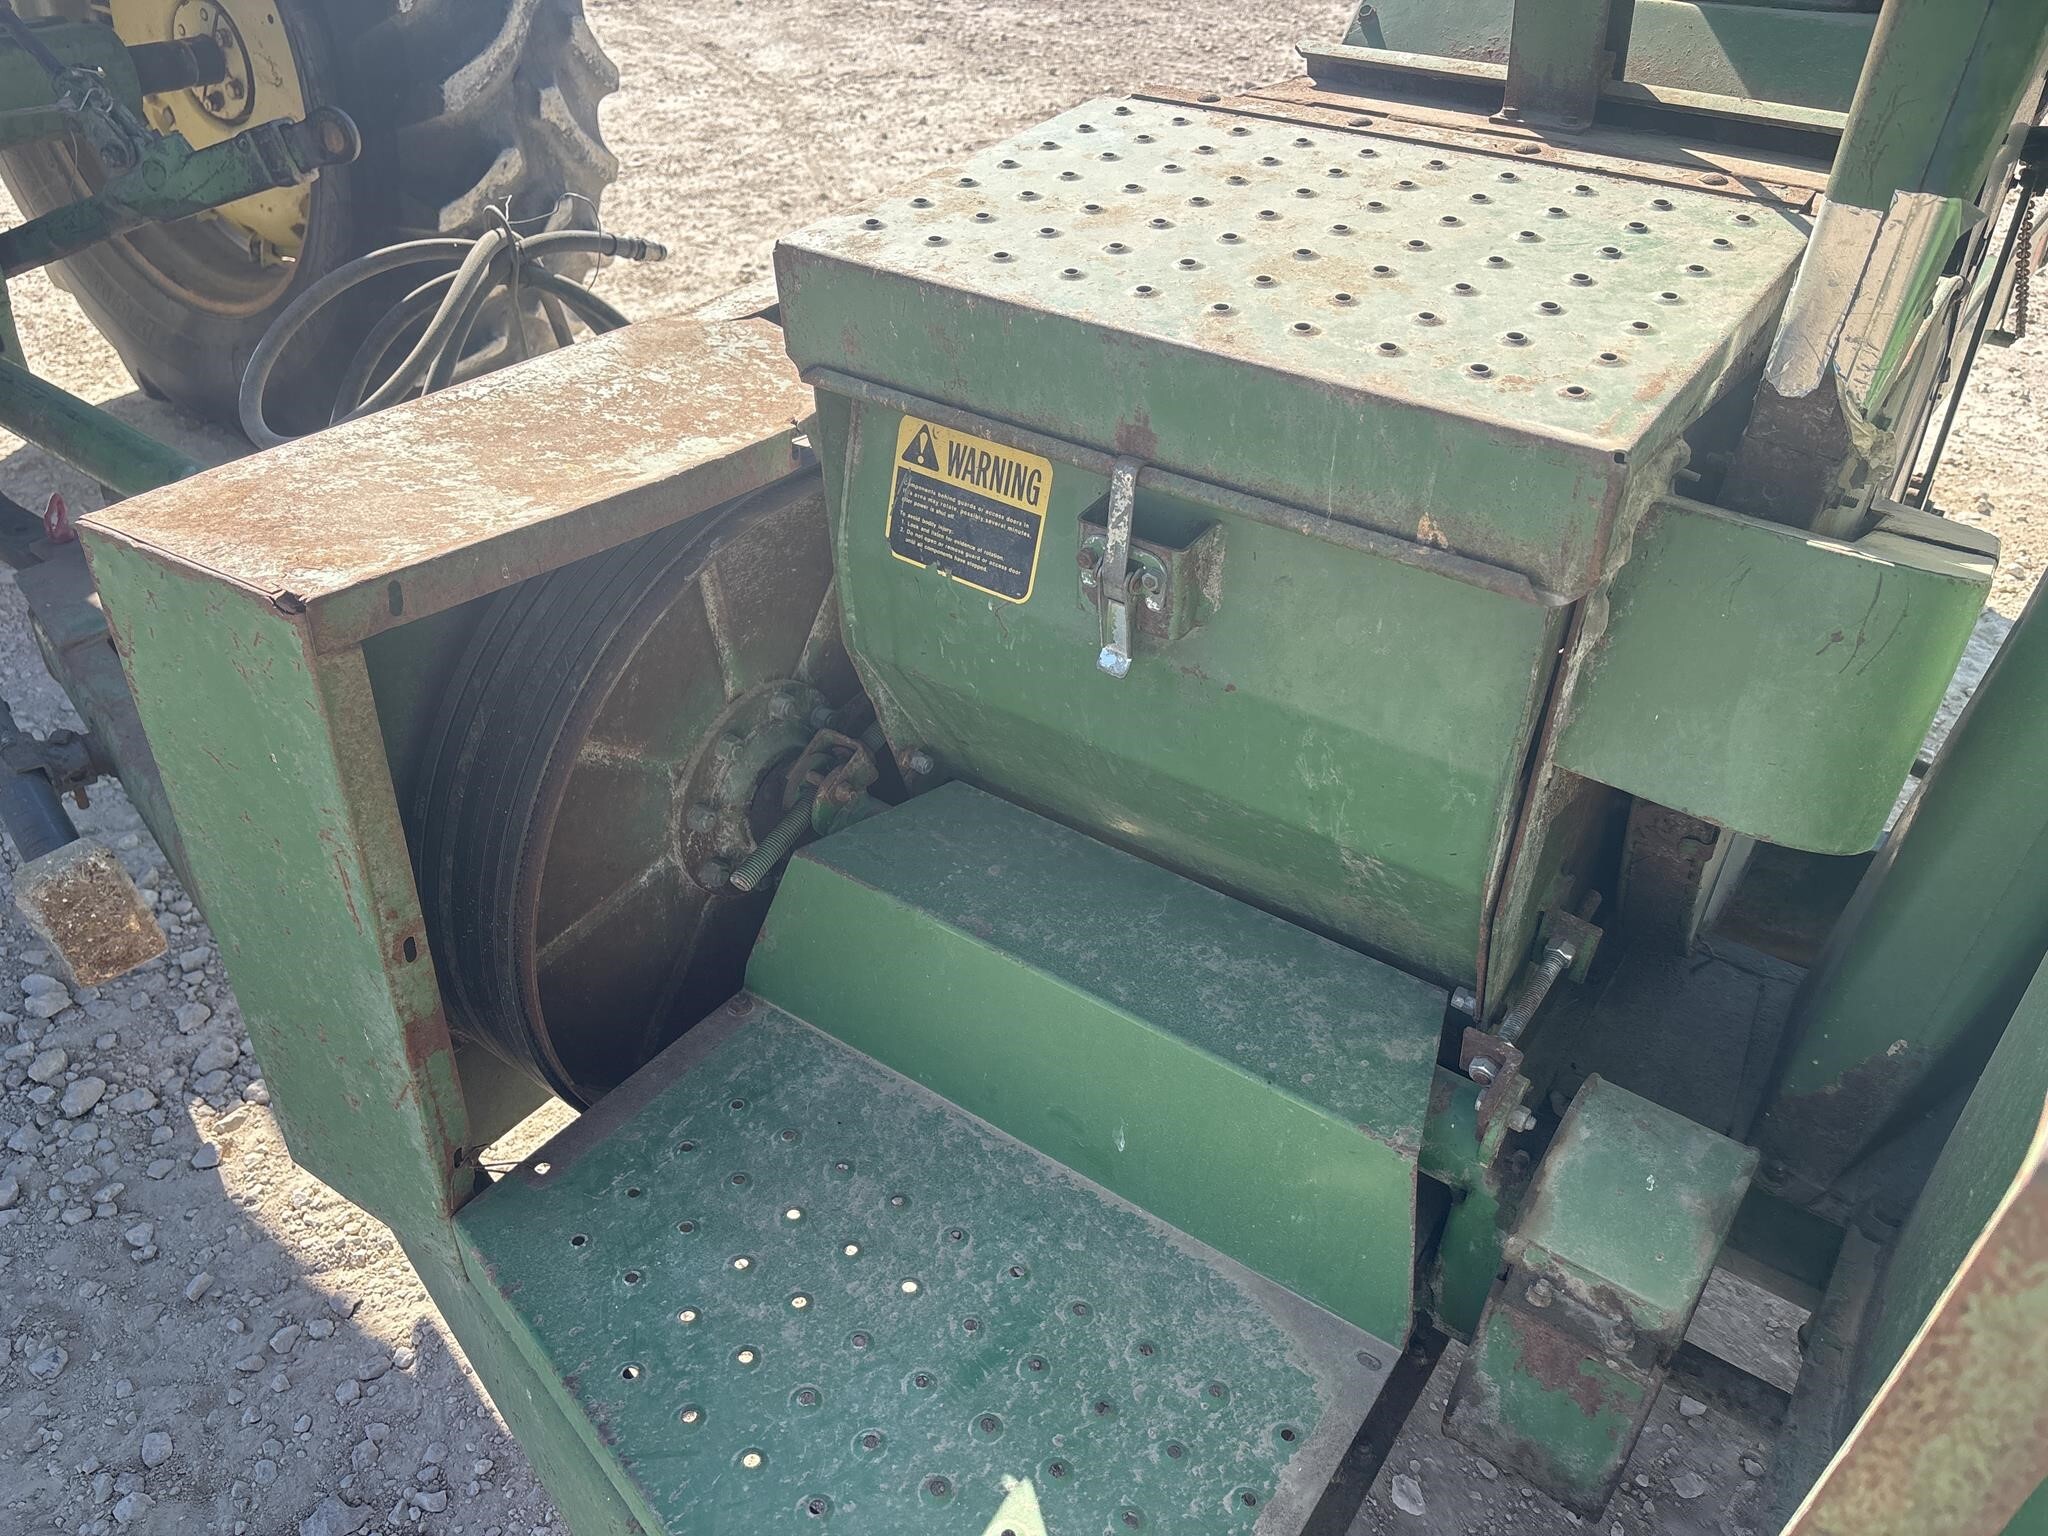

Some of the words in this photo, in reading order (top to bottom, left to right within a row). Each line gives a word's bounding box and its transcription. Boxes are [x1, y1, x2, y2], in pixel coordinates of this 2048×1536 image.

[947, 440, 1042, 507] WARNING
[914, 501, 928, 510] power
[928, 498, 939, 506] may
[960, 509, 983, 522] possibly
[985, 518, 1006, 529] several
[938, 492, 956, 502] behind
[958, 500, 976, 510] guards
[985, 508, 1004, 520] access
[1006, 516, 1022, 526] doors
[907, 513, 920, 521] avoid
[922, 518, 936, 528] bodily
[931, 530, 945, 539] listen
[954, 539, 975, 550] evidence
[924, 545, 953, 559] components
[954, 555, 966, 564] have
[924, 537, 937, 545] open
[945, 544, 964, 555] remove
[965, 552, 981, 561] guard
[989, 560, 1007, 571] access
[1008, 566, 1021, 575] door
